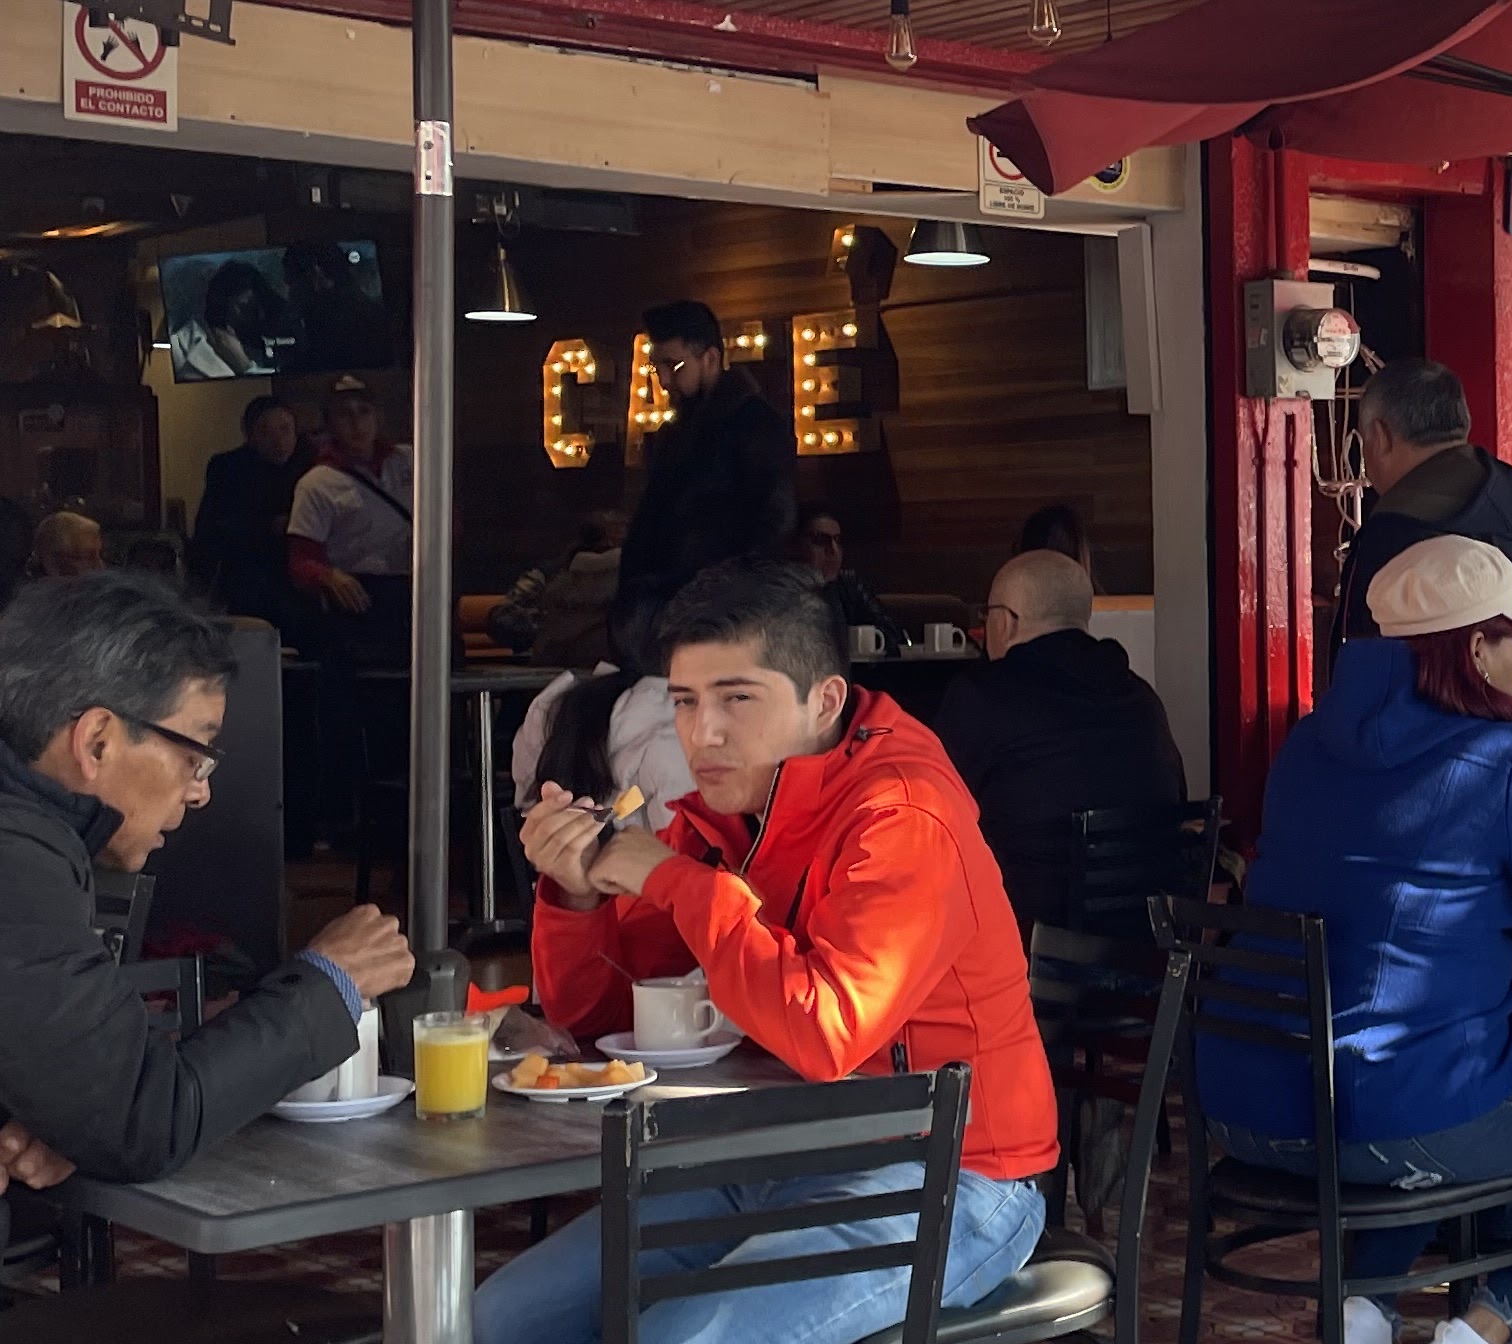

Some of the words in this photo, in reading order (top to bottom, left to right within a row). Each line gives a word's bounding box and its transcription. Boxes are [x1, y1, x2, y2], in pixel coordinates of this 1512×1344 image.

[88, 86, 154, 105] PROHIBIDO
[80, 97, 96, 111] EL
[98, 100, 164, 118] CONTACTO
